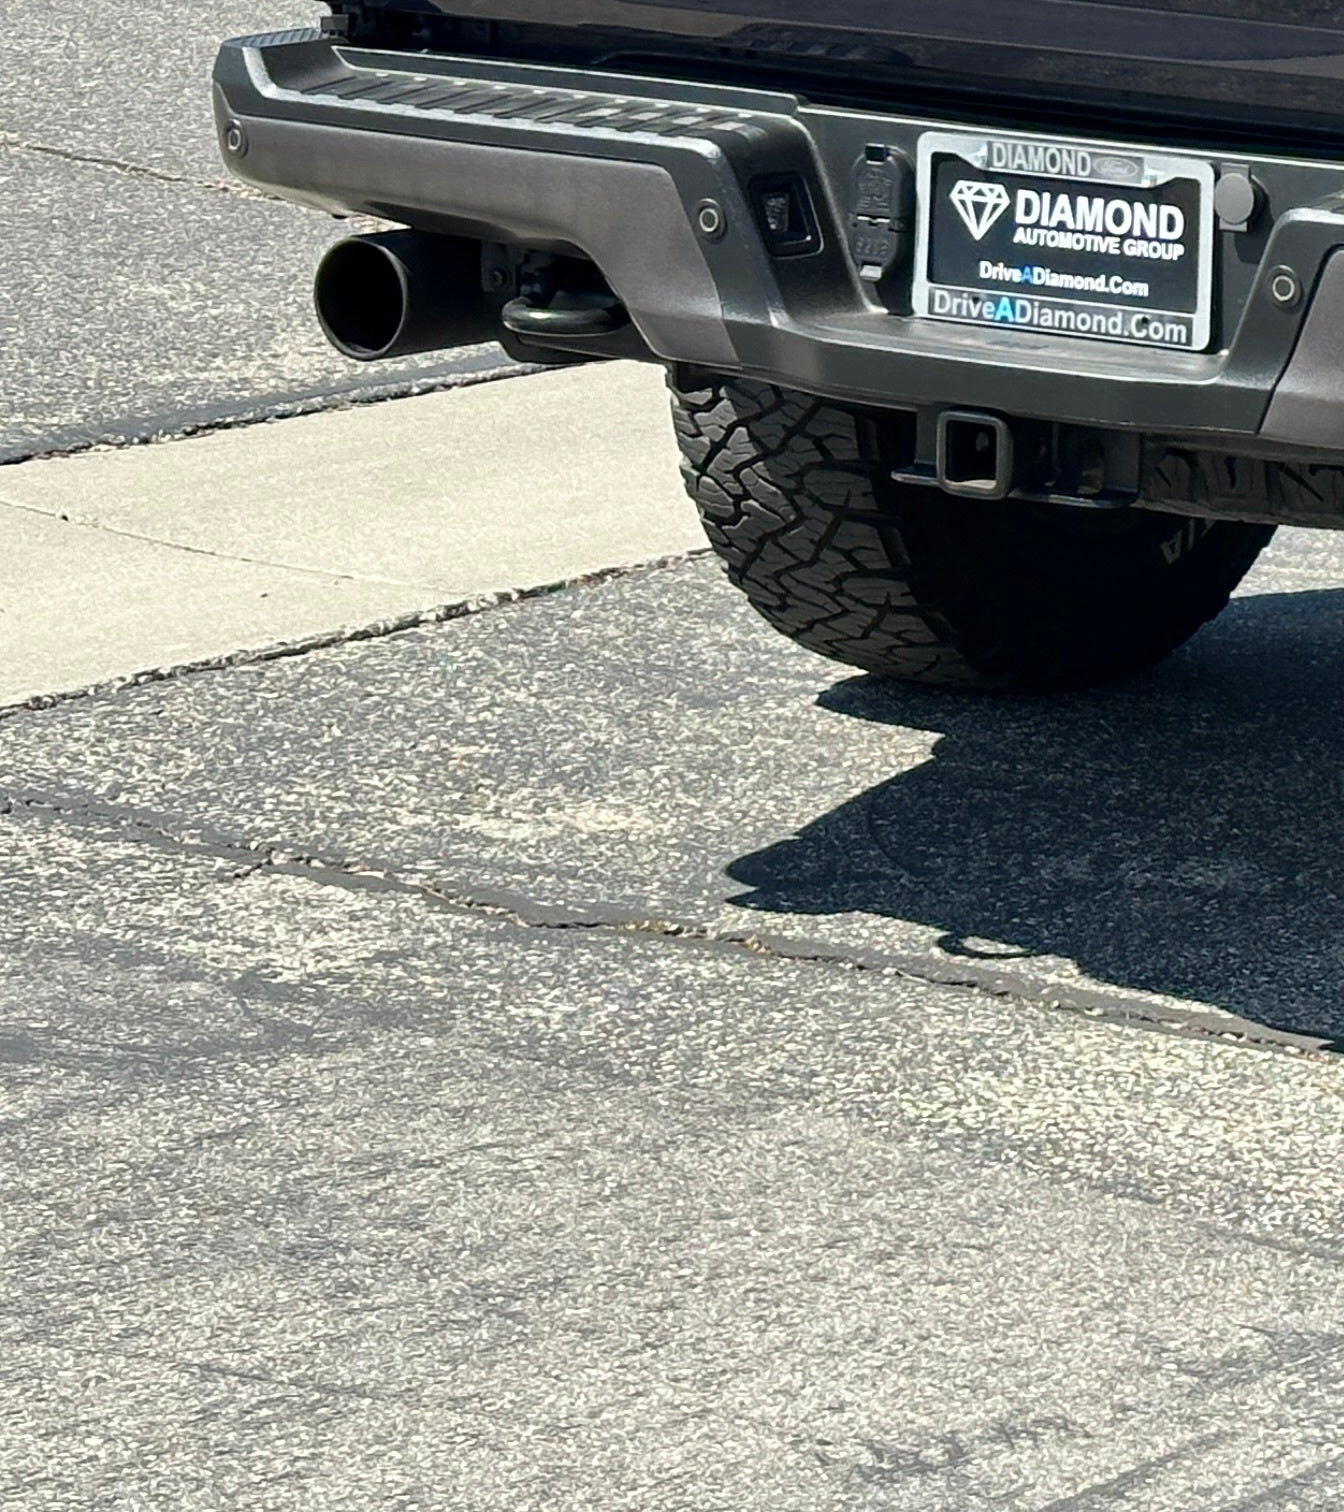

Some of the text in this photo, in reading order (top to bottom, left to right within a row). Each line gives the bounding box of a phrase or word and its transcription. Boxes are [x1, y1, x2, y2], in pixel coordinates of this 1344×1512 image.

[991, 142, 1093, 178] DIAMOND
[1015, 189, 1185, 241] DIAMOND
[1013, 226, 1186, 261] AUTOMOTIVE GROUP
[979, 260, 1150, 297] DriveADiamond.Com
[933, 291, 1188, 345] DriveADiamond.Com
